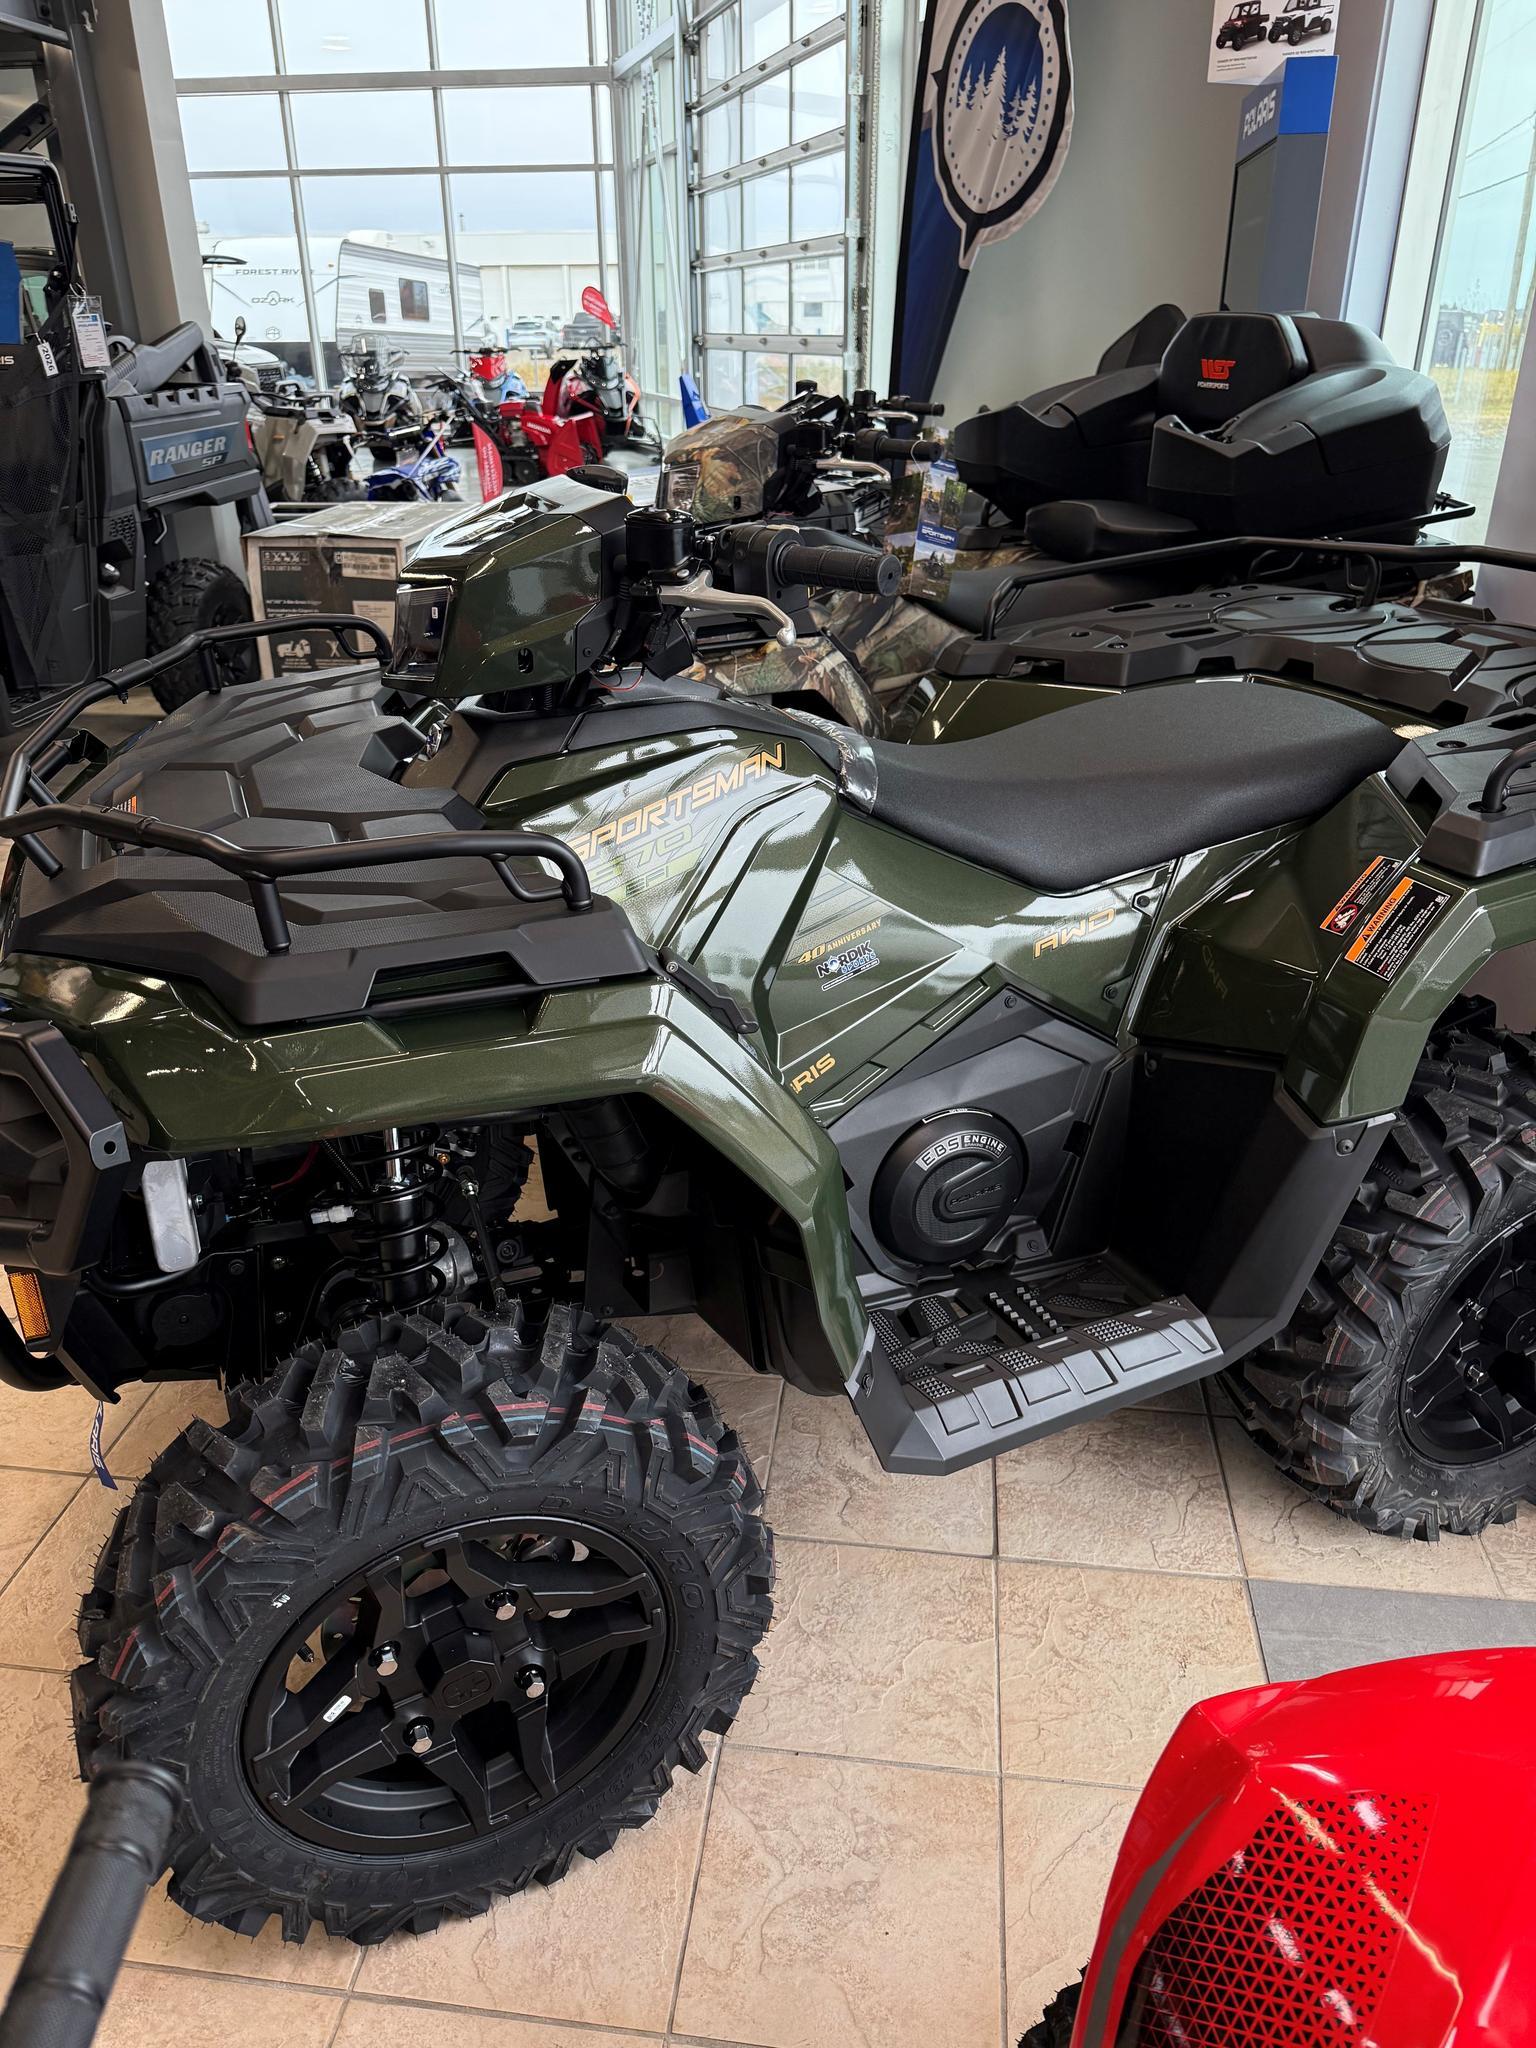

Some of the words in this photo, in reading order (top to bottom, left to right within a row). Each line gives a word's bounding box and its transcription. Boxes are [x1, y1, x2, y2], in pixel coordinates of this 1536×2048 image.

[1243, 89, 1277, 140] POLARIS
[251, 293, 296, 305] OZARK
[42, 346, 56, 372] 2026
[150, 436, 226, 466] RANGER
[202, 455, 223, 467] SP
[566, 742, 786, 864] SPORTSMAN
[1368, 896, 1398, 933] WARNING
[797, 943, 826, 964] 40
[827, 917, 881, 953] ANNIVERSARY
[1033, 907, 1116, 960] AWD
[816, 940, 874, 979] NORDIK
[841, 951, 877, 974] SPORTS
[921, 1137, 960, 1167] EBS
[963, 1134, 1005, 1153] ENGINE
